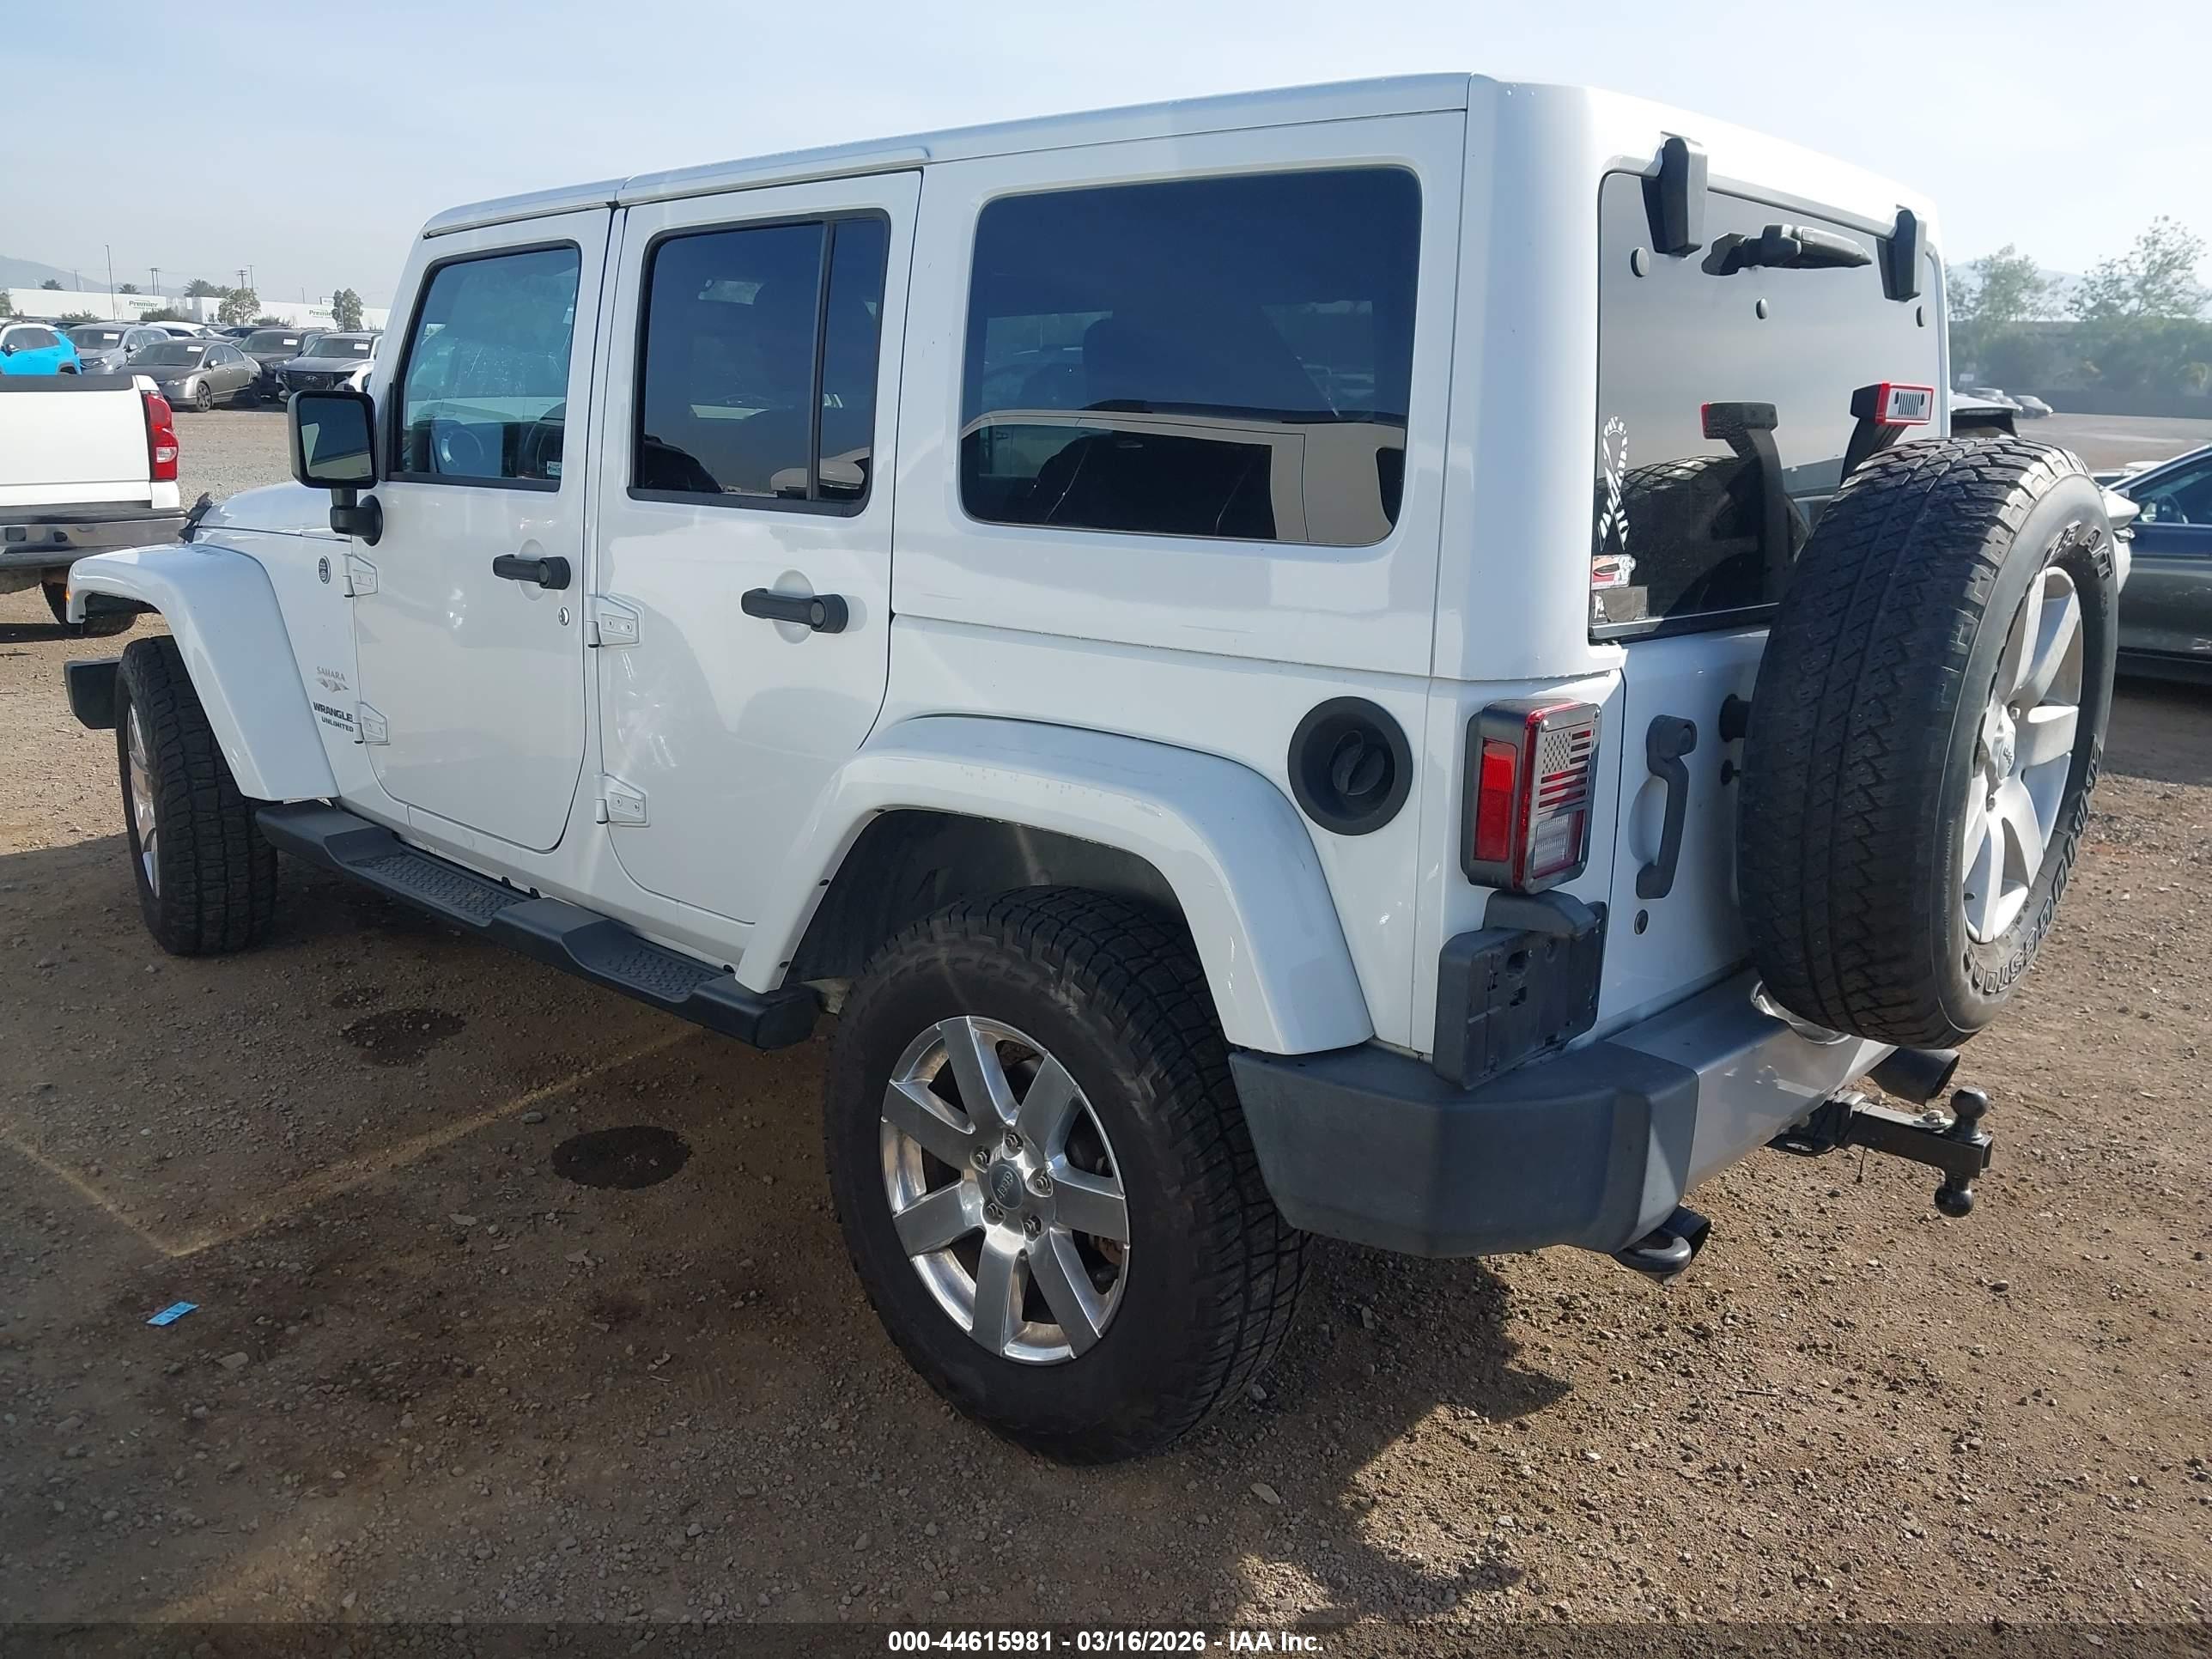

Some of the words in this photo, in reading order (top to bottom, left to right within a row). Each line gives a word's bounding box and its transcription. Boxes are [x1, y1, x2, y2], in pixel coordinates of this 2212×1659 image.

[129, 300, 159, 308] Premier
[316, 665, 346, 682] SAHARA
[313, 701, 354, 722] WRANGLE
[321, 716, 355, 732] UNLIMITED
[996, 1170, 1014, 1200] Jeep
